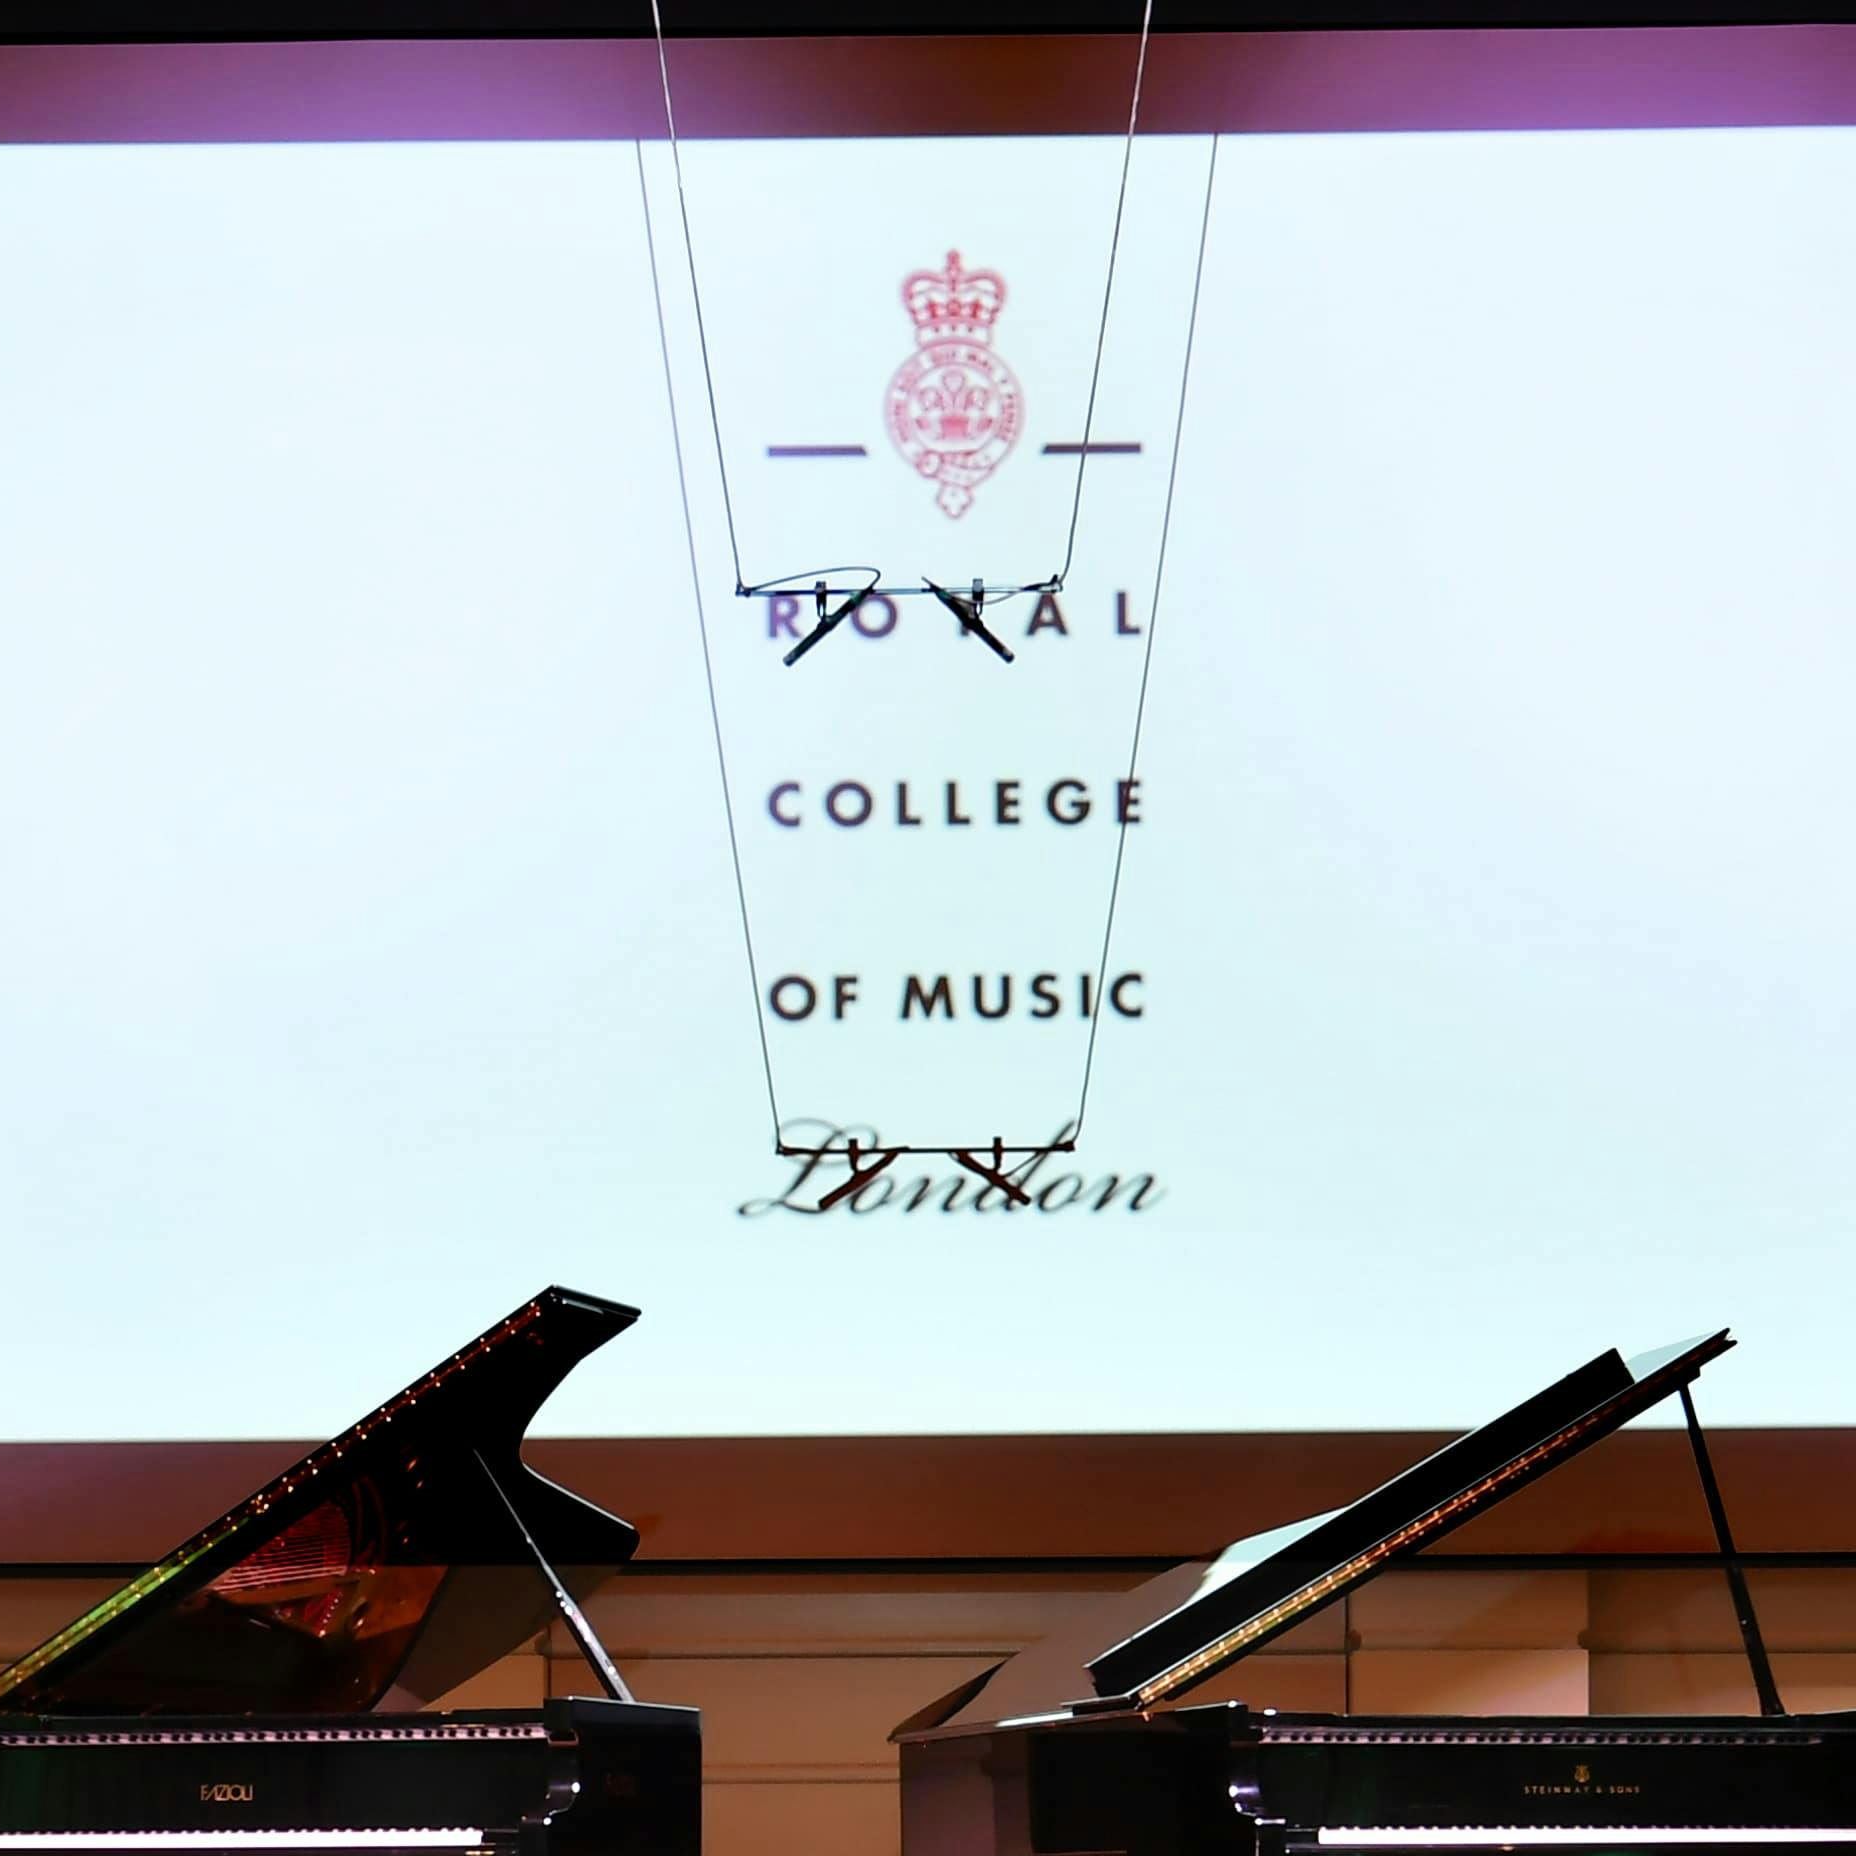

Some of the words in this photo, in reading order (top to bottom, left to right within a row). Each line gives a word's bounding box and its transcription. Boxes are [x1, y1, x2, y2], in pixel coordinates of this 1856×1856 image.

[768, 592, 1141, 638] ROAL
[768, 781, 1143, 826] COLLEGE
[769, 974, 861, 1021] OF
[901, 973, 1143, 1019] MUSIC
[738, 1118, 1163, 1216] London
